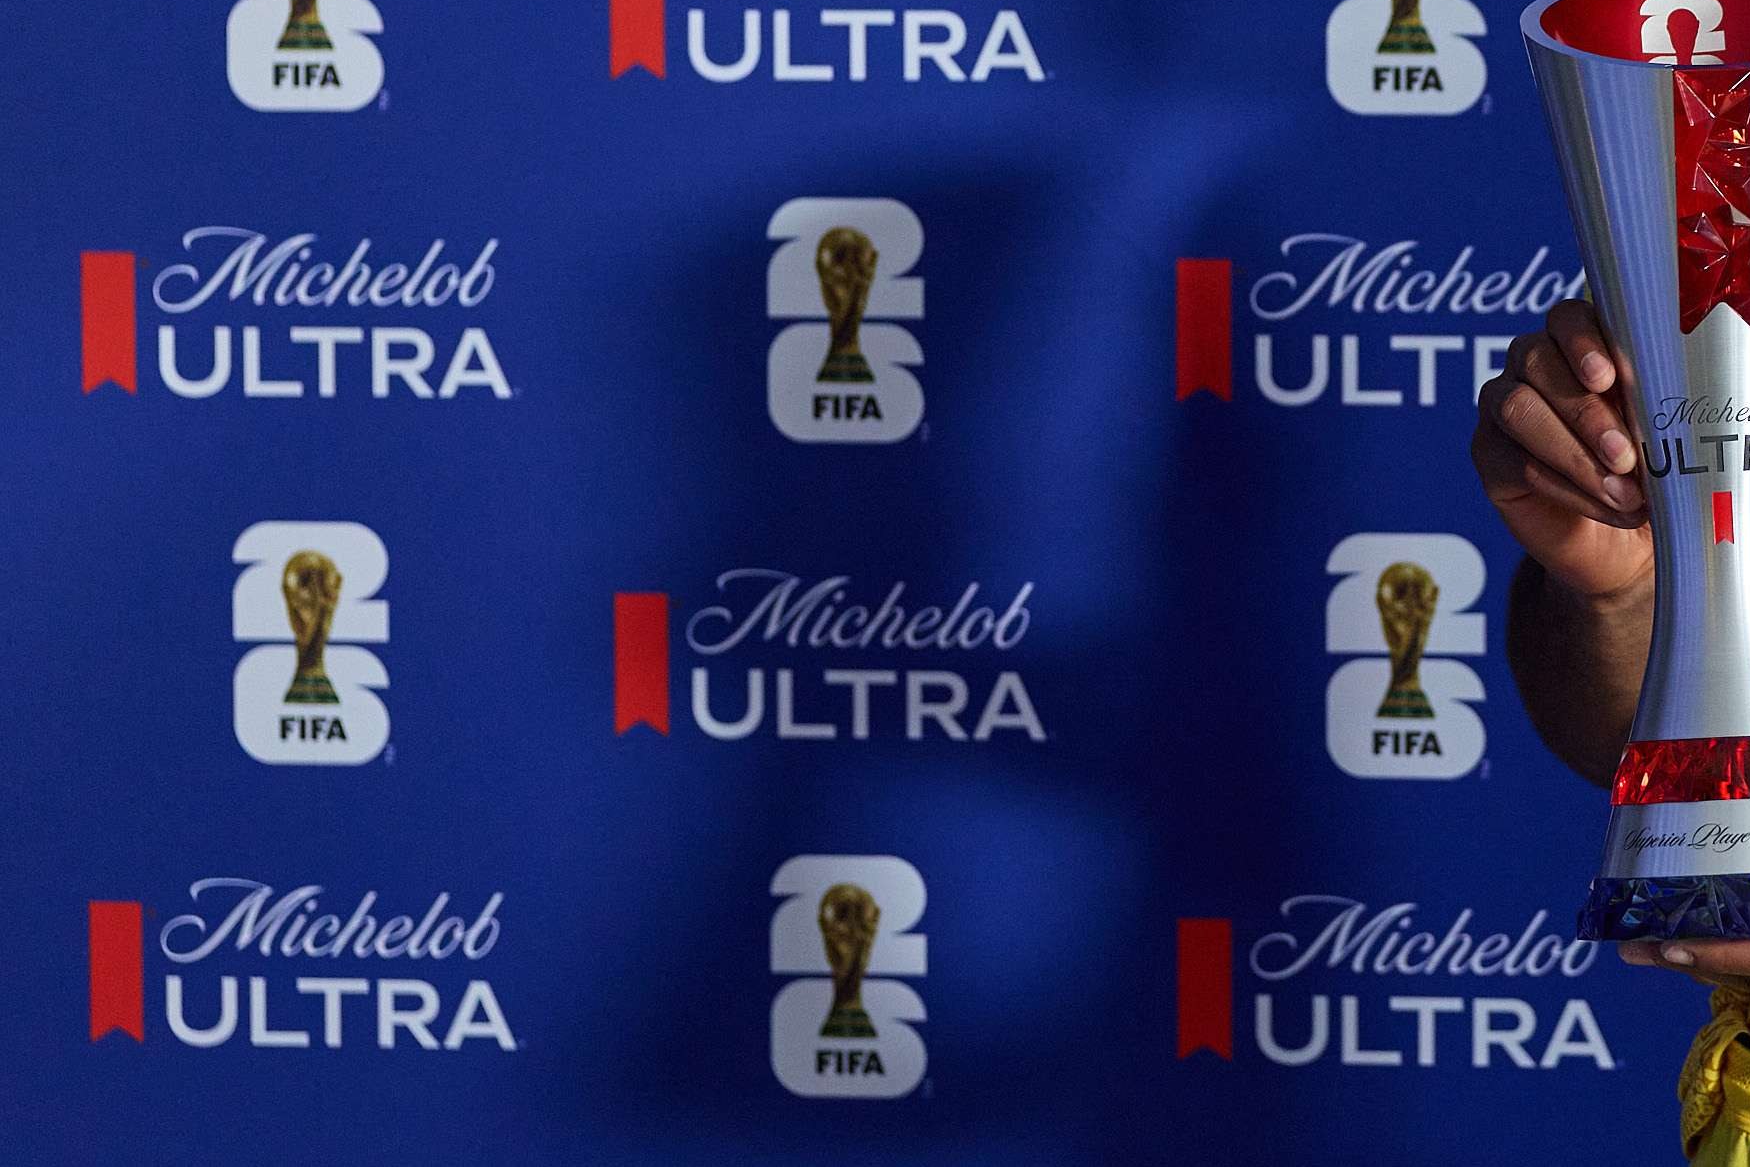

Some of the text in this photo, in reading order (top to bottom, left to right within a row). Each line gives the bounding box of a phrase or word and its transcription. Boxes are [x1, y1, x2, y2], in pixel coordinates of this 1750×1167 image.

[273, 63, 341, 87] FIFA
[688, 9, 1044, 82] ULTRA
[1373, 66, 1444, 92] FIFA
[153, 227, 497, 313] Michelob
[159, 326, 512, 398] ULTRA
[1255, 334, 1517, 407] ULT
[813, 394, 883, 421] FIFA
[688, 570, 1034, 654] Michelob
[280, 716, 347, 741] FIFA
[692, 667, 1046, 740] ULTRA
[1372, 730, 1442, 756] FIFA
[1624, 827, 1686, 856] Superior
[161, 878, 502, 962] Michelob
[166, 975, 516, 1050] ULTRA
[1256, 995, 1615, 1069] ULTRA
[816, 1049, 885, 1075] FIFA
